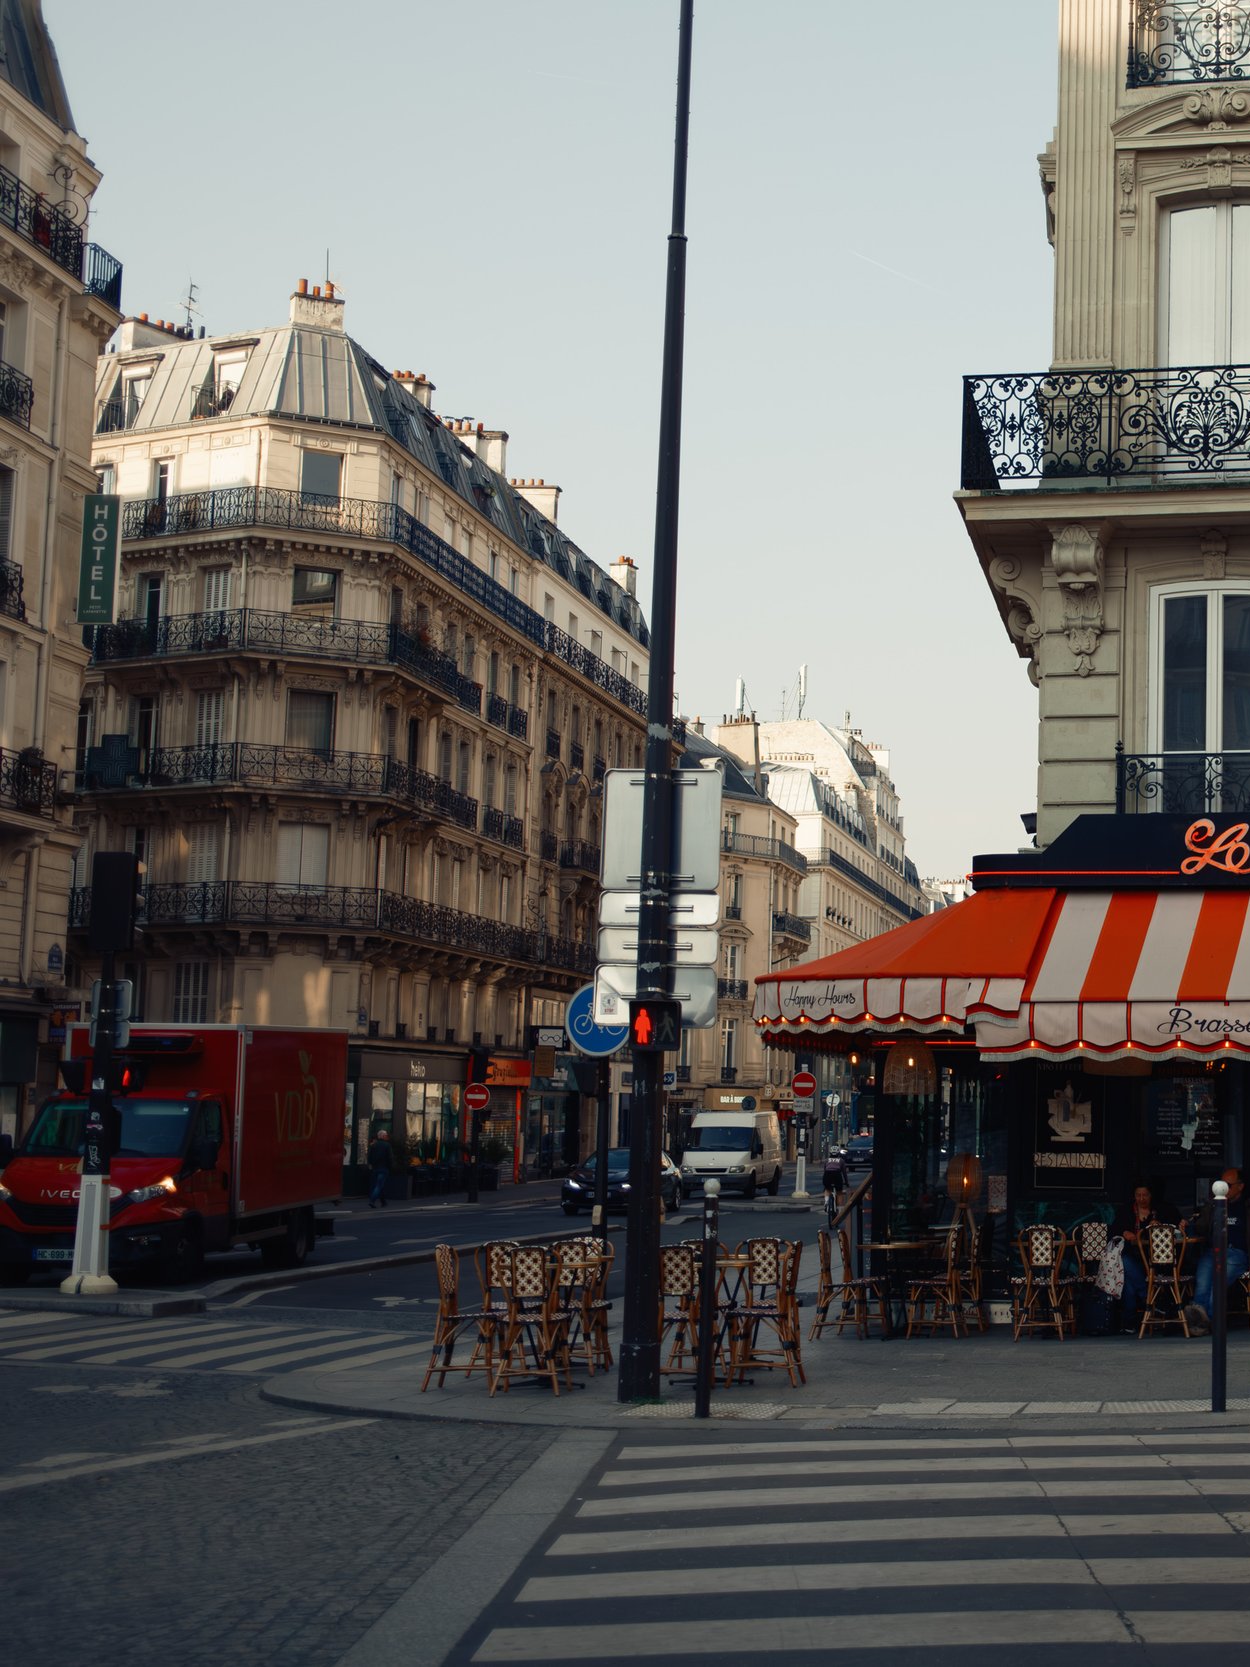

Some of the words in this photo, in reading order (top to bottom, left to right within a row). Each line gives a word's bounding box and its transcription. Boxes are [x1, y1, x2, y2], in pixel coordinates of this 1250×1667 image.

[91, 505, 108, 600] HÔTEL
[784, 985, 815, 1007] Happy
[818, 982, 856, 1007] Hours
[40, 1189, 81, 1199] IVEC
